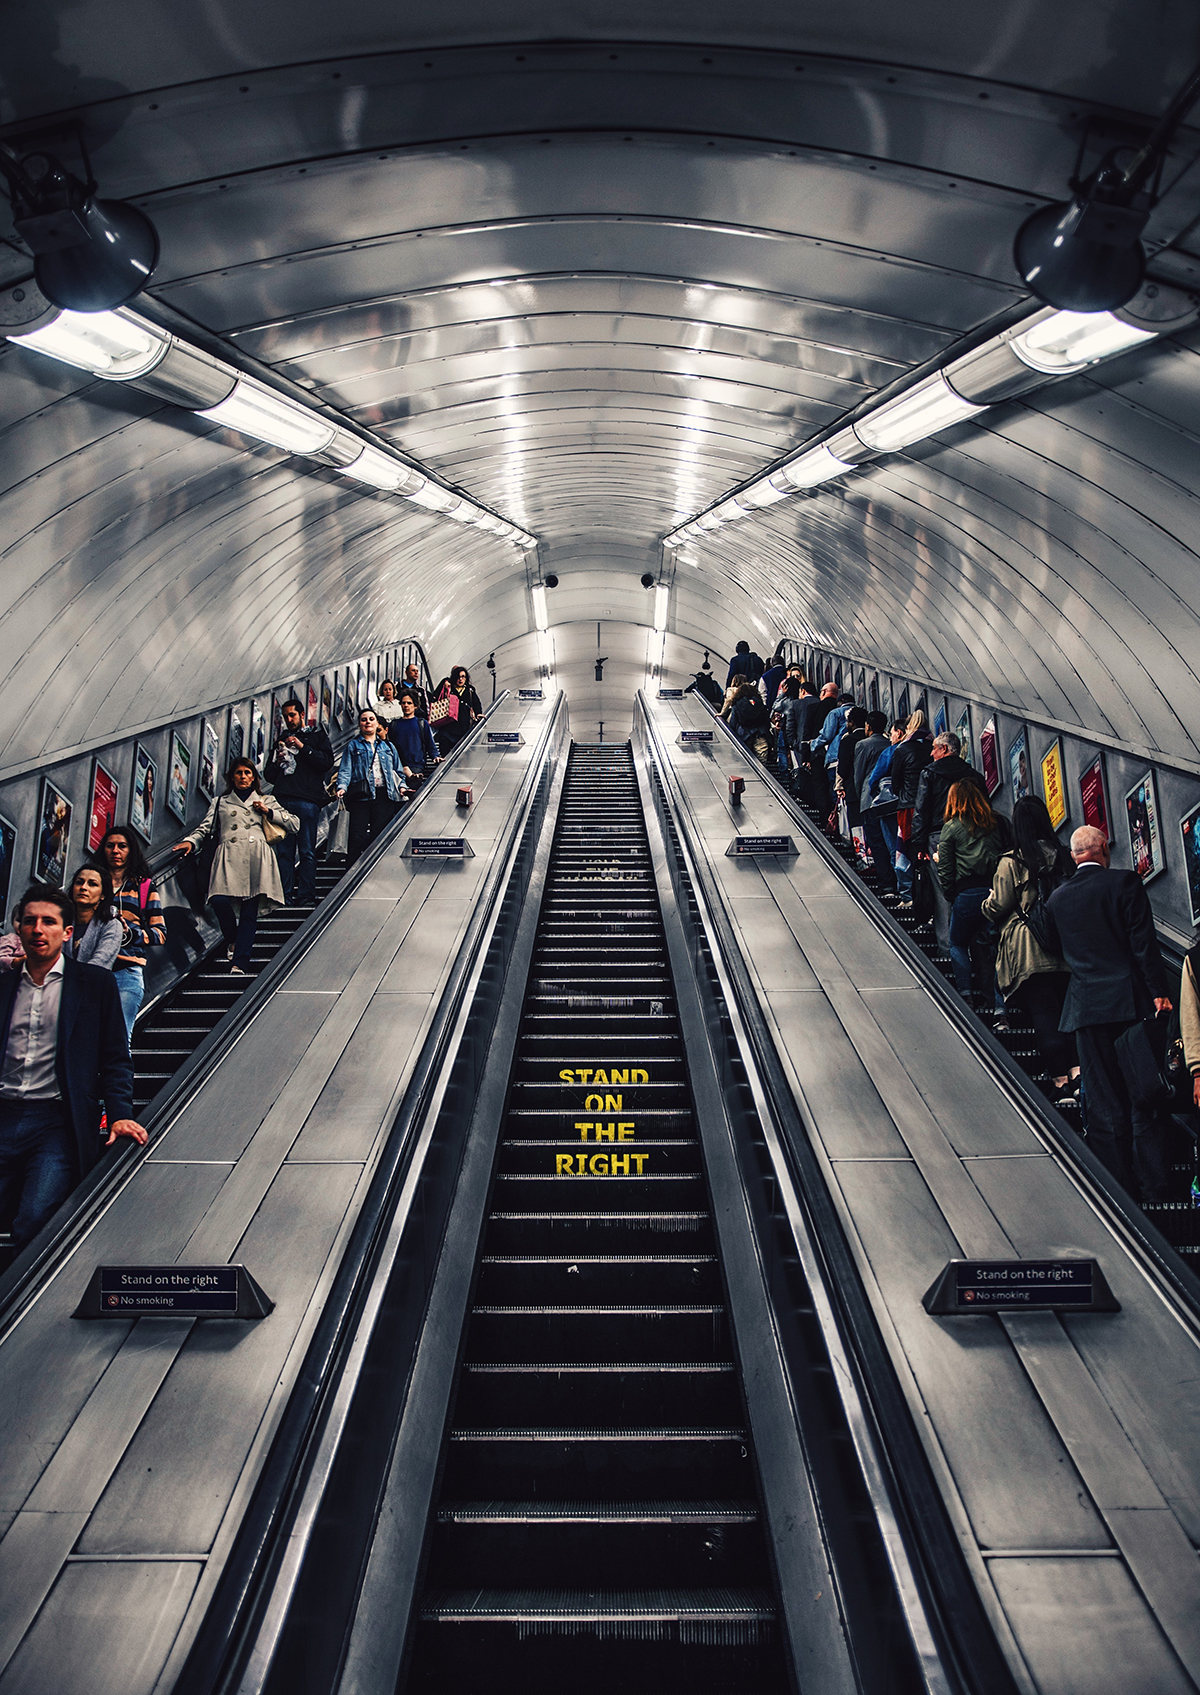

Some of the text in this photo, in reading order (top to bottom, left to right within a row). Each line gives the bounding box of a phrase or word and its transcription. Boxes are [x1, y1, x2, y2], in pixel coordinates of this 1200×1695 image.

[558, 1068, 649, 1085] STAND
[584, 1094, 623, 1112] ON
[574, 1122, 635, 1142] THE
[555, 1153, 649, 1175] RIGHT
[121, 1274, 219, 1287] Stand on the right
[976, 1269, 1074, 1281] Stand on the right
[120, 1296, 174, 1307] No smoking
[976, 1291, 1030, 1301] No smoking
